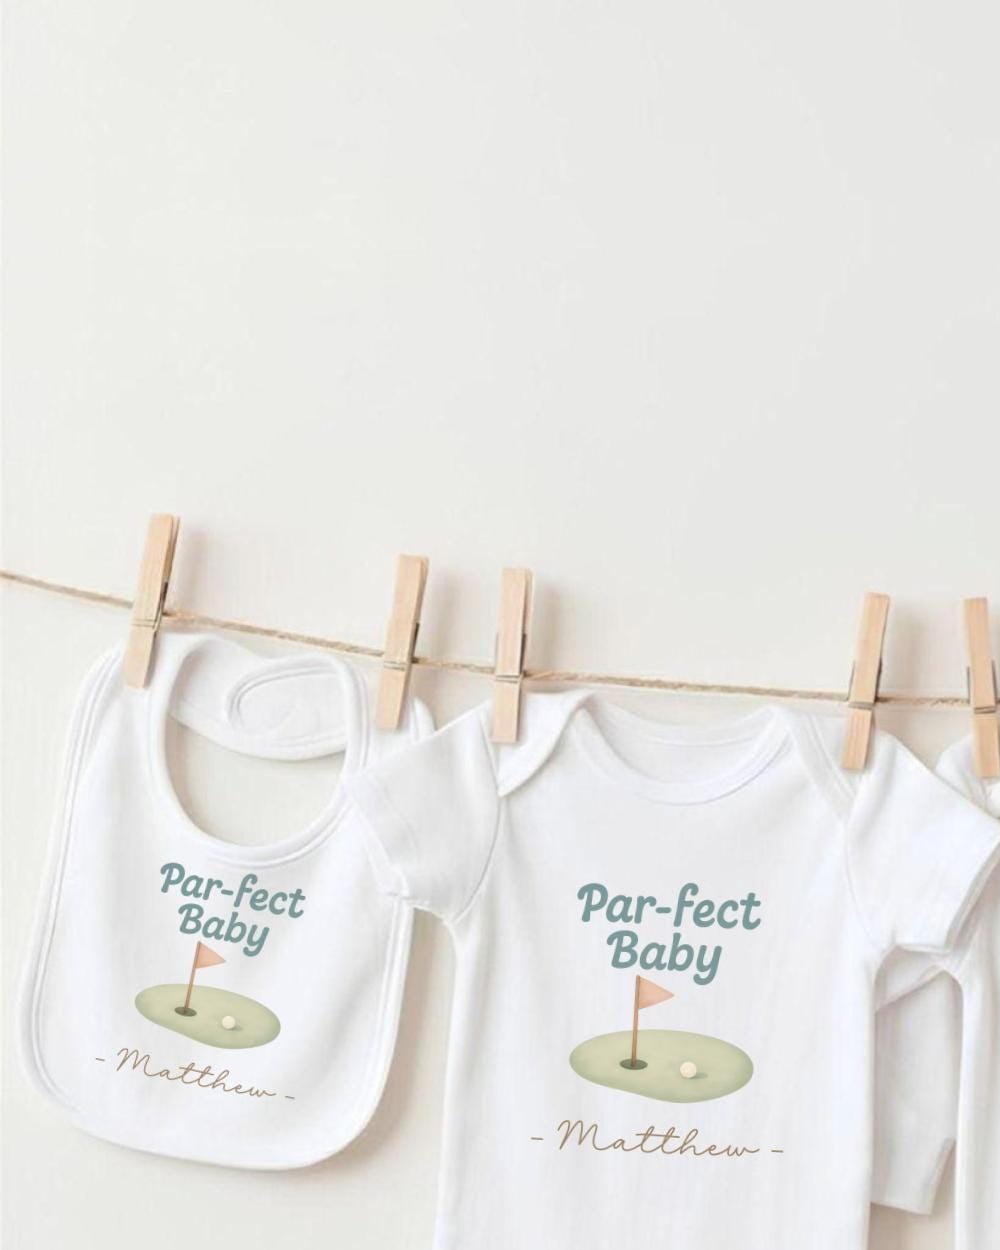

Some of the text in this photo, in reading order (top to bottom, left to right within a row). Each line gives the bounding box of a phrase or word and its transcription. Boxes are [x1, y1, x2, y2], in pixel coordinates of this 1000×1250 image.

[160, 862, 306, 919] Par-fect
[577, 883, 762, 930] Par-fect
[178, 903, 270, 957] Baby
[606, 930, 722, 985] Baby
[116, 1047, 277, 1098] Matthew
[556, 1119, 761, 1158] Matthew
